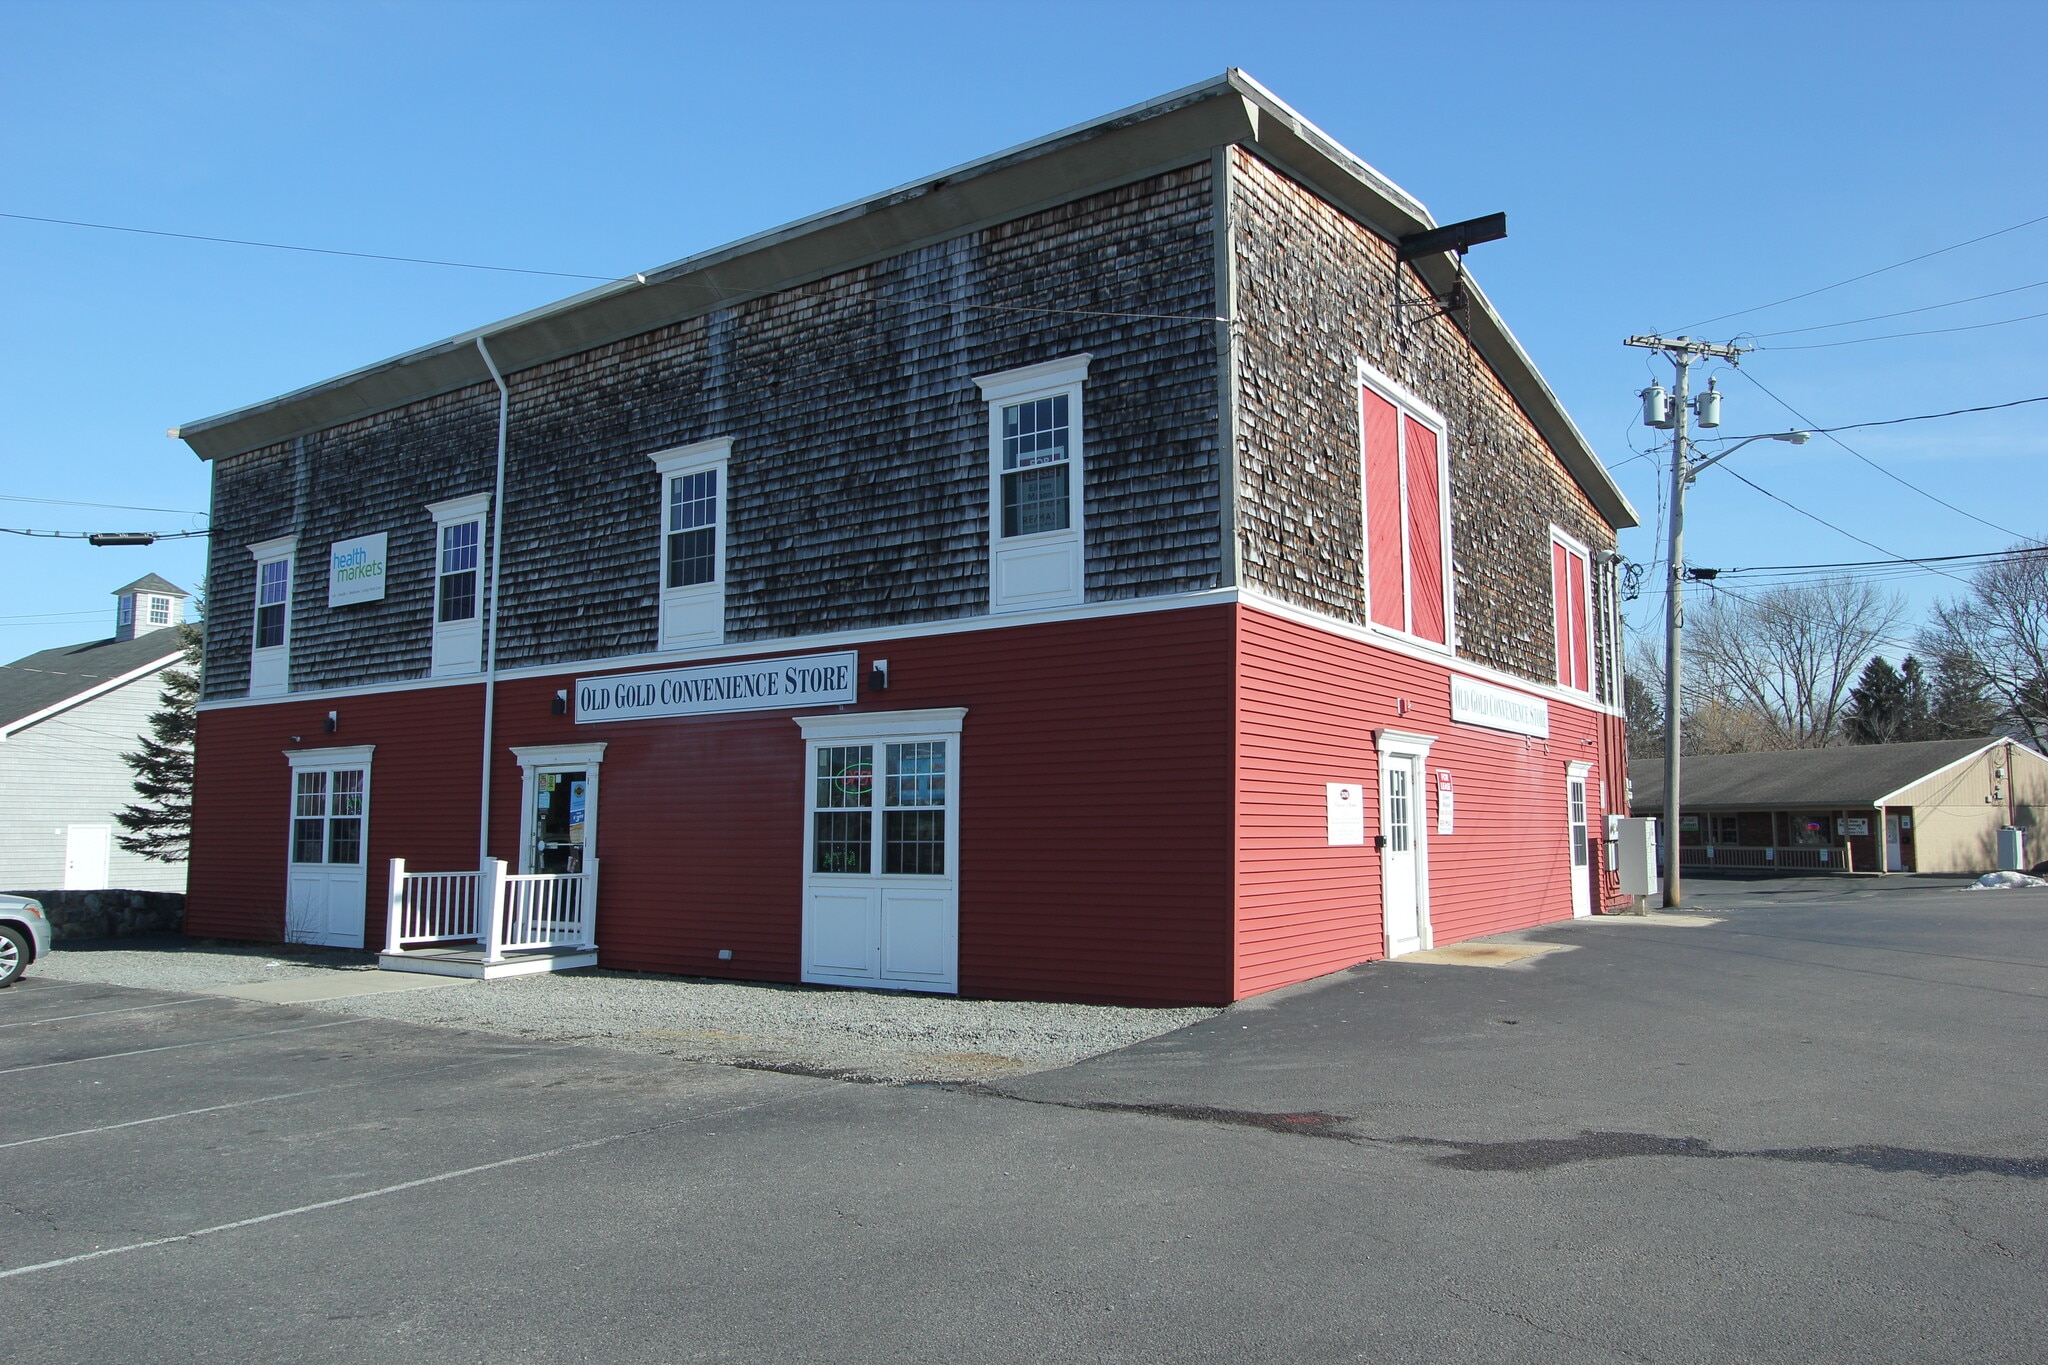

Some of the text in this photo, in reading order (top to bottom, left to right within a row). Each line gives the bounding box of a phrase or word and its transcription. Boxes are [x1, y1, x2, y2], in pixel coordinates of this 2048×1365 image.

[333, 547, 366, 569] health
[338, 560, 382, 582] markets
[580, 665, 849, 712] OLD GOLD CONVENIENCE STORE
